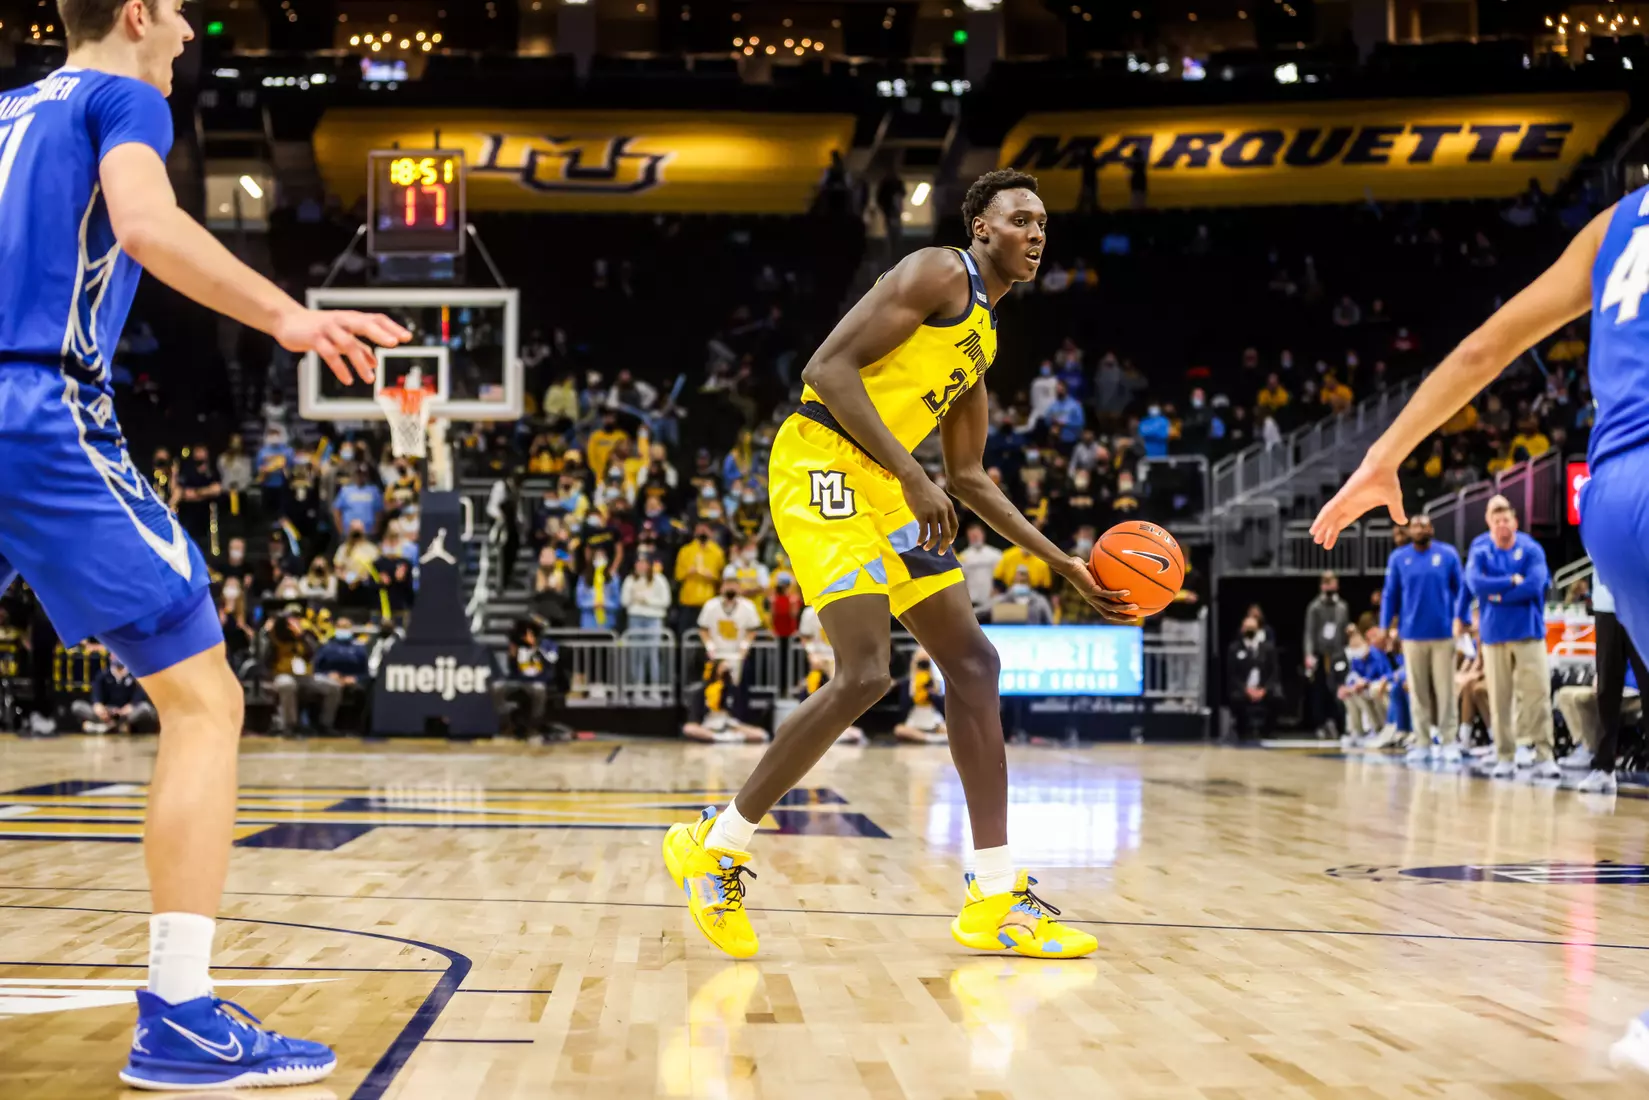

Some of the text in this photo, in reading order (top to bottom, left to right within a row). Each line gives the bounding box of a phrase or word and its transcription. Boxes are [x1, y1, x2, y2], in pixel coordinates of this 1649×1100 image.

[1009, 122, 1573, 170] MARQUETTE
[391, 157, 453, 186] 18:51
[405, 184, 447, 226] 17
[807, 469, 858, 520] MU
[385, 655, 492, 701] meijer
